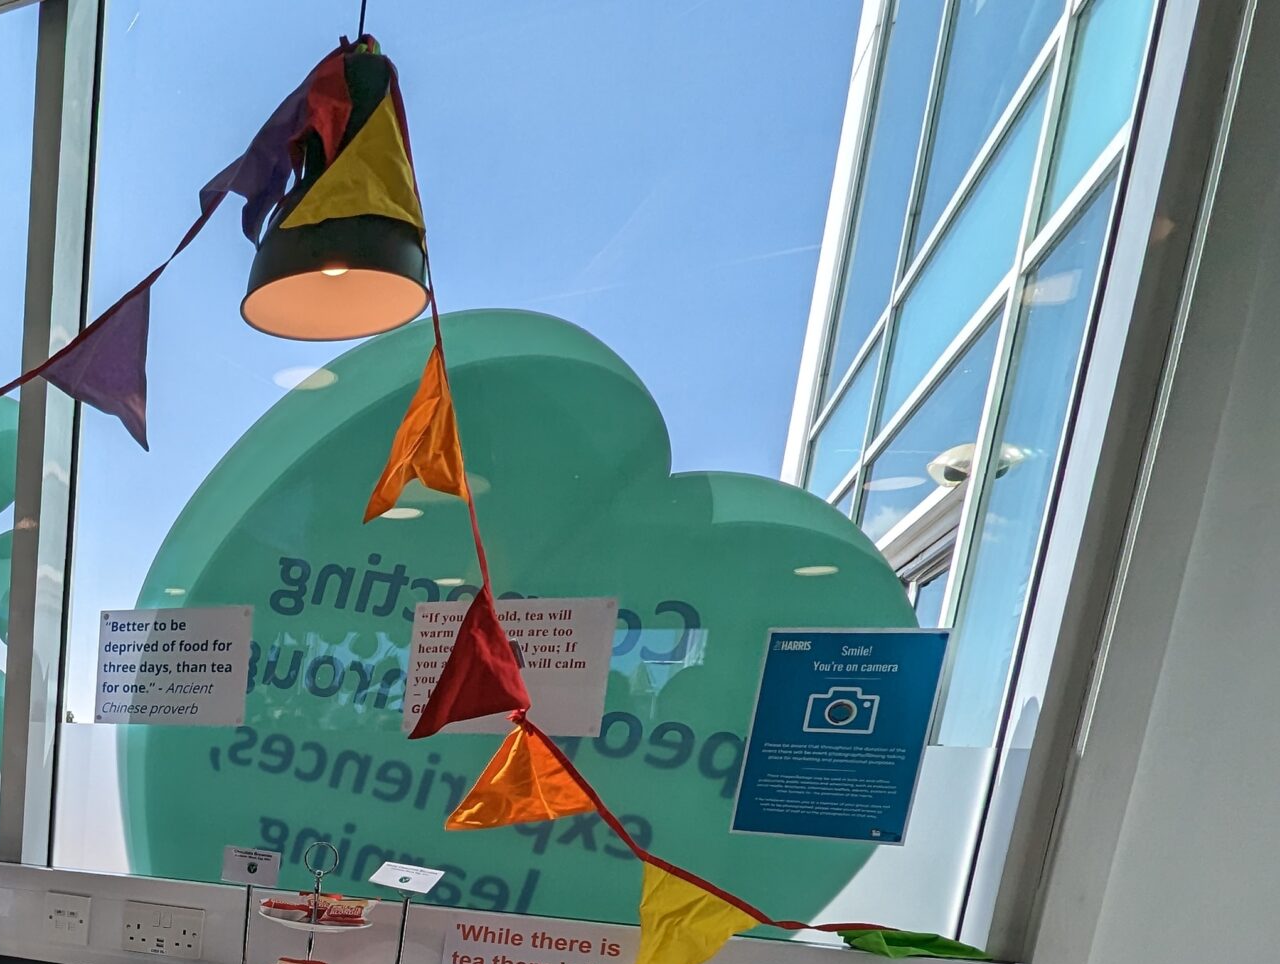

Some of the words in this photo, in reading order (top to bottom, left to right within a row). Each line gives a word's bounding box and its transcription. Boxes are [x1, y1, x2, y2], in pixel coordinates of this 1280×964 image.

[442, 614, 463, 625] you
[525, 611, 544, 621] tea
[548, 609, 572, 621] will
[153, 620, 167, 631] to
[170, 619, 187, 631] be
[420, 629, 454, 638] warm
[527, 628, 549, 637] are
[552, 627, 573, 637] too
[104, 640, 159, 655] deprived
[162, 640, 176, 652] of
[179, 640, 209, 652] food
[212, 639, 233, 652] for
[532, 644, 560, 655] you;
[565, 642, 577, 653] If
[780, 640, 812, 651] HARRIS
[841, 645, 873, 657] Smile!
[103, 661, 136, 673] three
[139, 661, 172, 676] days,
[176, 661, 207, 673] than
[211, 662, 233, 673] tea
[415, 661, 437, 671] you
[528, 658, 551, 669] will
[555, 658, 586, 669] calm
[845, 663, 858, 672] on
[860, 663, 899, 673] camera
[102, 682, 119, 694] for
[165, 683, 214, 694] Ancient
[101, 702, 148, 715] Chinese
[149, 702, 199, 717] proverb
[530, 931, 592, 954] there
[599, 938, 621, 957] is
